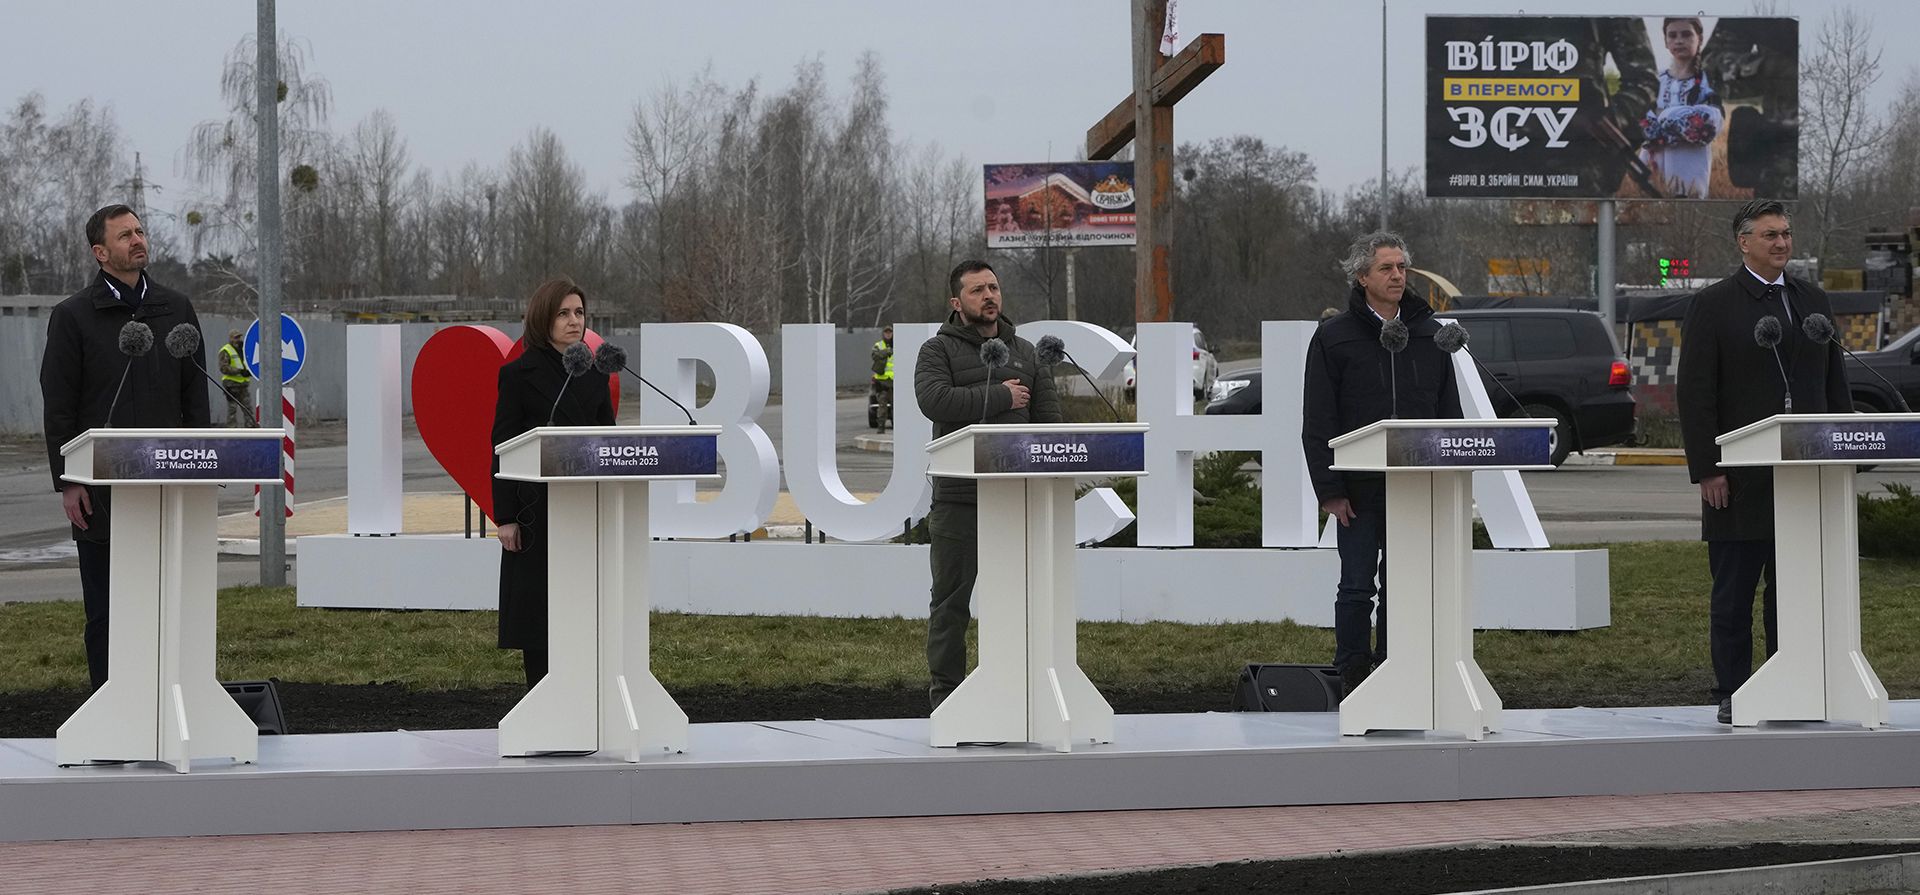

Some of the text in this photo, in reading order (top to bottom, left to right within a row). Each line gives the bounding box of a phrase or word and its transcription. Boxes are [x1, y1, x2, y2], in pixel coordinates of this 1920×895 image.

[1451, 84, 1573, 96] В ПЕРЕМОГУ
[1447, 106, 1578, 151] ЗСУ
[347, 325, 402, 536] I
[1832, 431, 1886, 442] BUCHA
[1440, 437, 1496, 448] BUCHA
[599, 446, 659, 457] BUCHA
[1030, 443, 1088, 454] BUCHA
[155, 449, 218, 460] BUCHA
[169, 461, 195, 469] March
[197, 461, 218, 469] 2023
[612, 458, 637, 466] March
[639, 458, 659, 466] 2023
